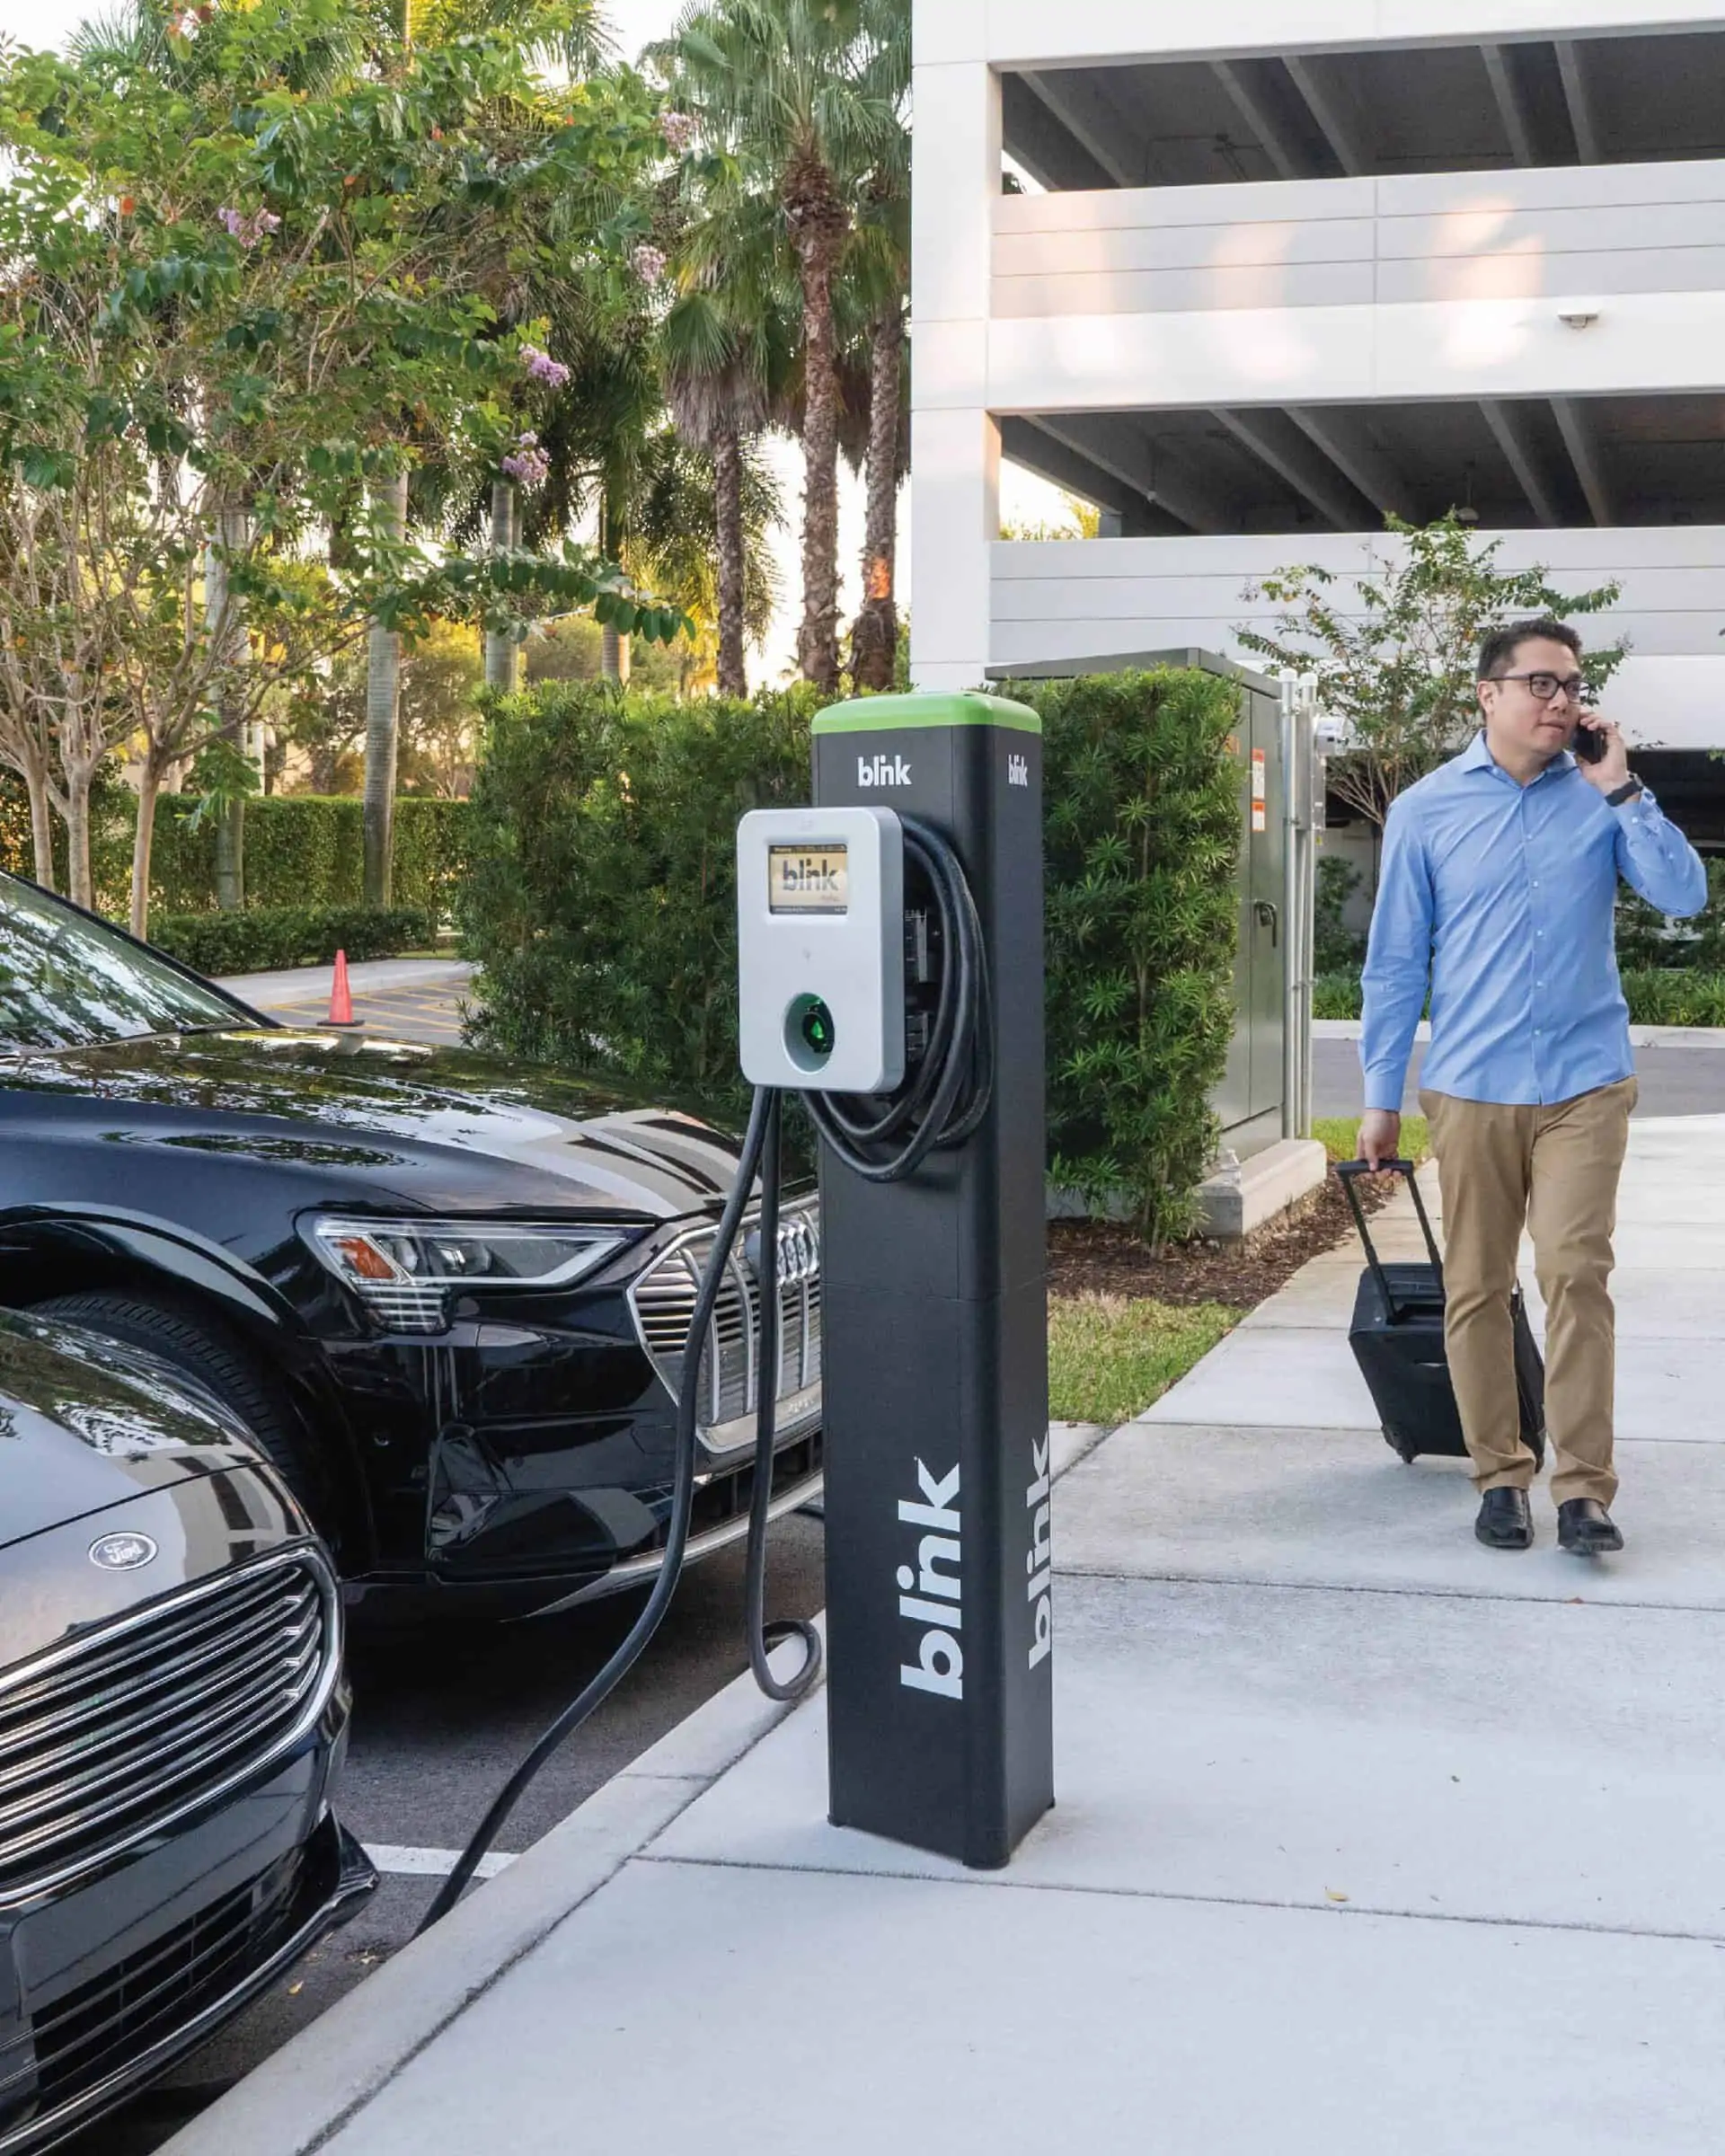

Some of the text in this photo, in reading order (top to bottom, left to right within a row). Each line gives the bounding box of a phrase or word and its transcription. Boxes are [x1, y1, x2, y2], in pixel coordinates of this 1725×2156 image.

[857, 755, 913, 787] blink
[1007, 755, 1028, 787] blink
[783, 858, 839, 891] blink
[103, 1539, 145, 1564] Ford
[1026, 1430, 1052, 1671] blink
[896, 1456, 963, 1701] blink
